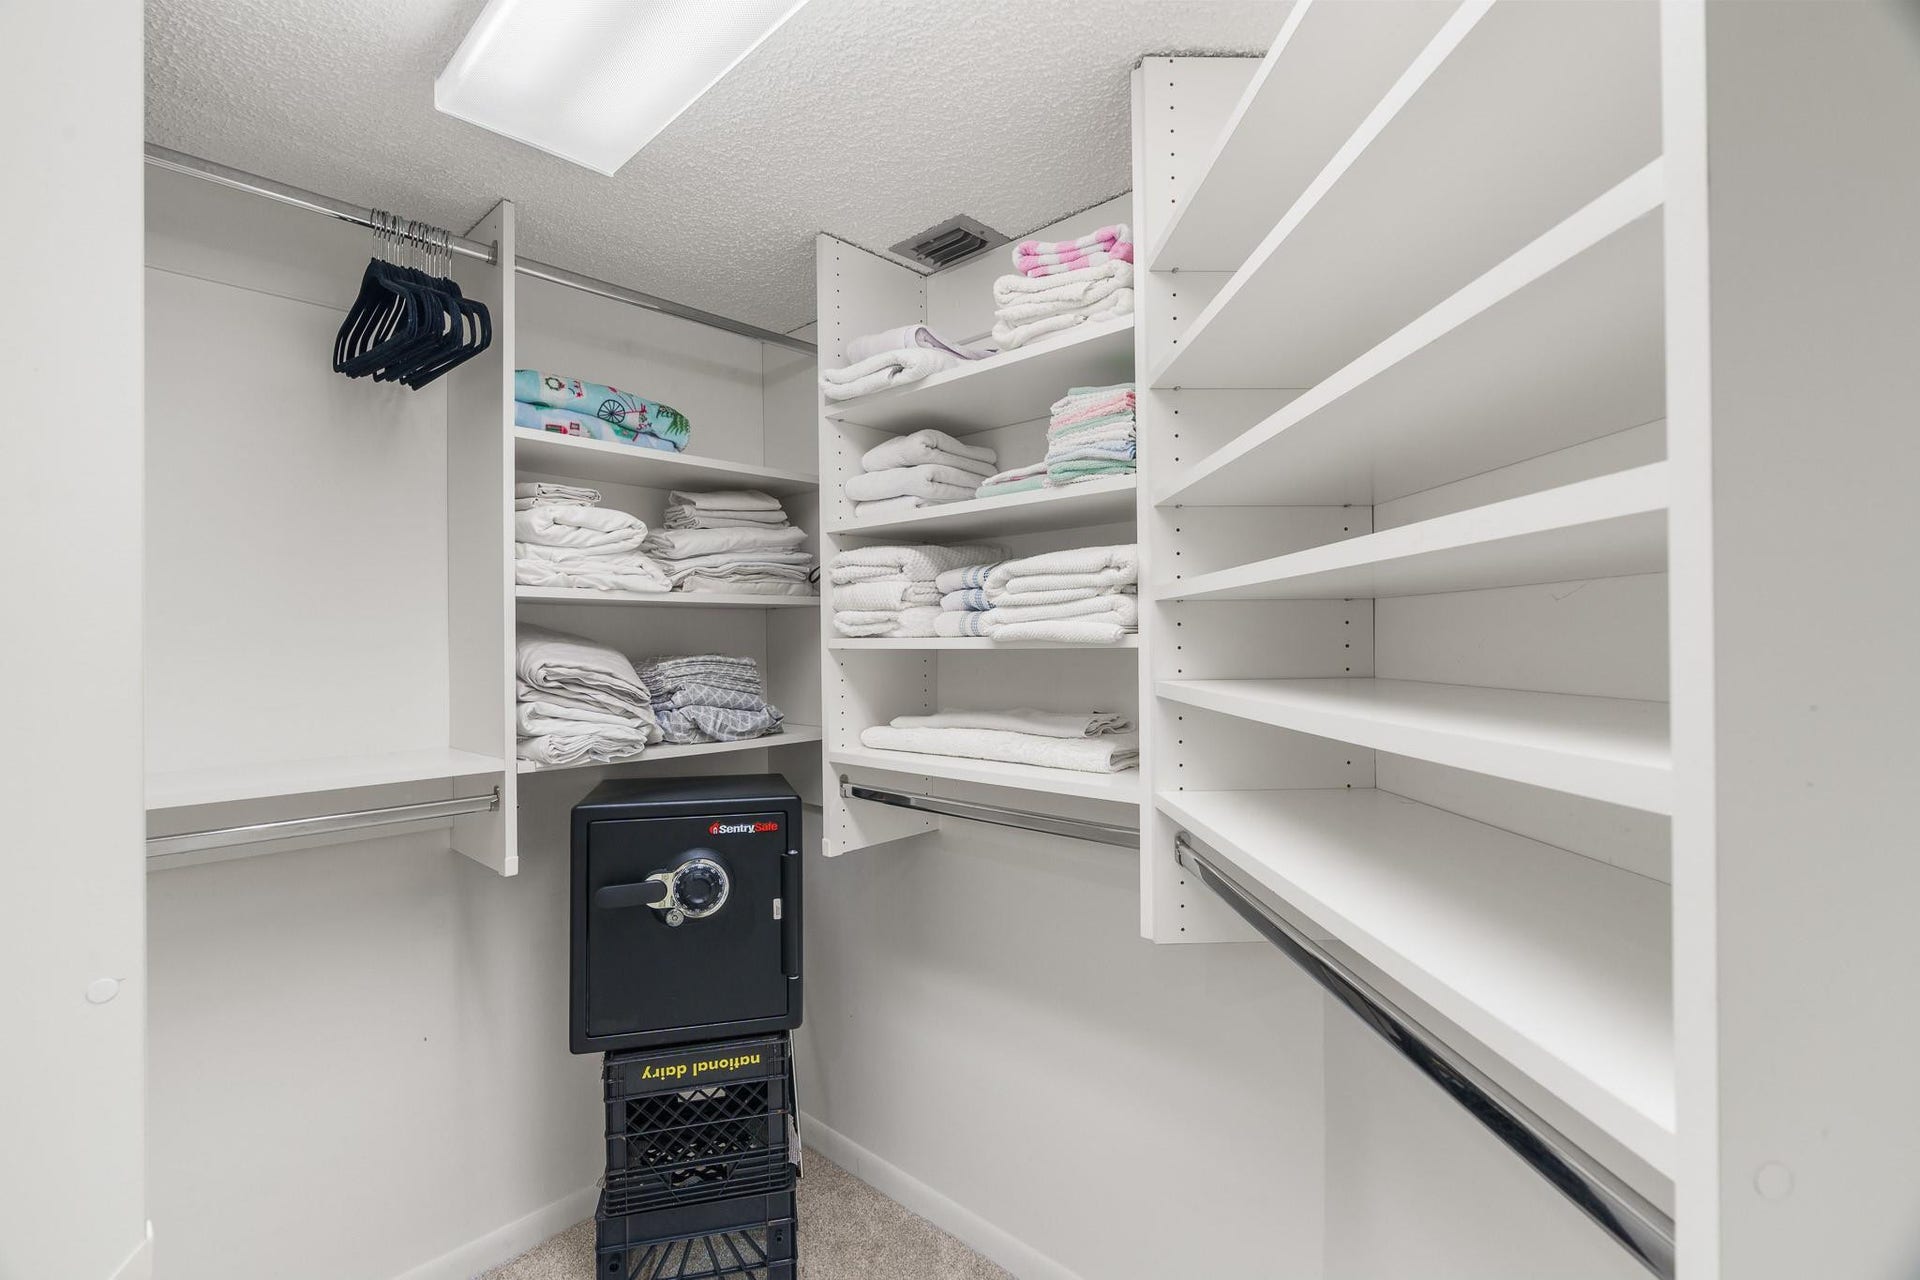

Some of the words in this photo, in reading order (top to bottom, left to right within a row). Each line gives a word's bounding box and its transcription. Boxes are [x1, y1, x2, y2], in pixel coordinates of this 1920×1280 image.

[719, 821, 778, 834] SentrySafe
[641, 1064, 688, 1081] dairy
[693, 1054, 760, 1077] national
